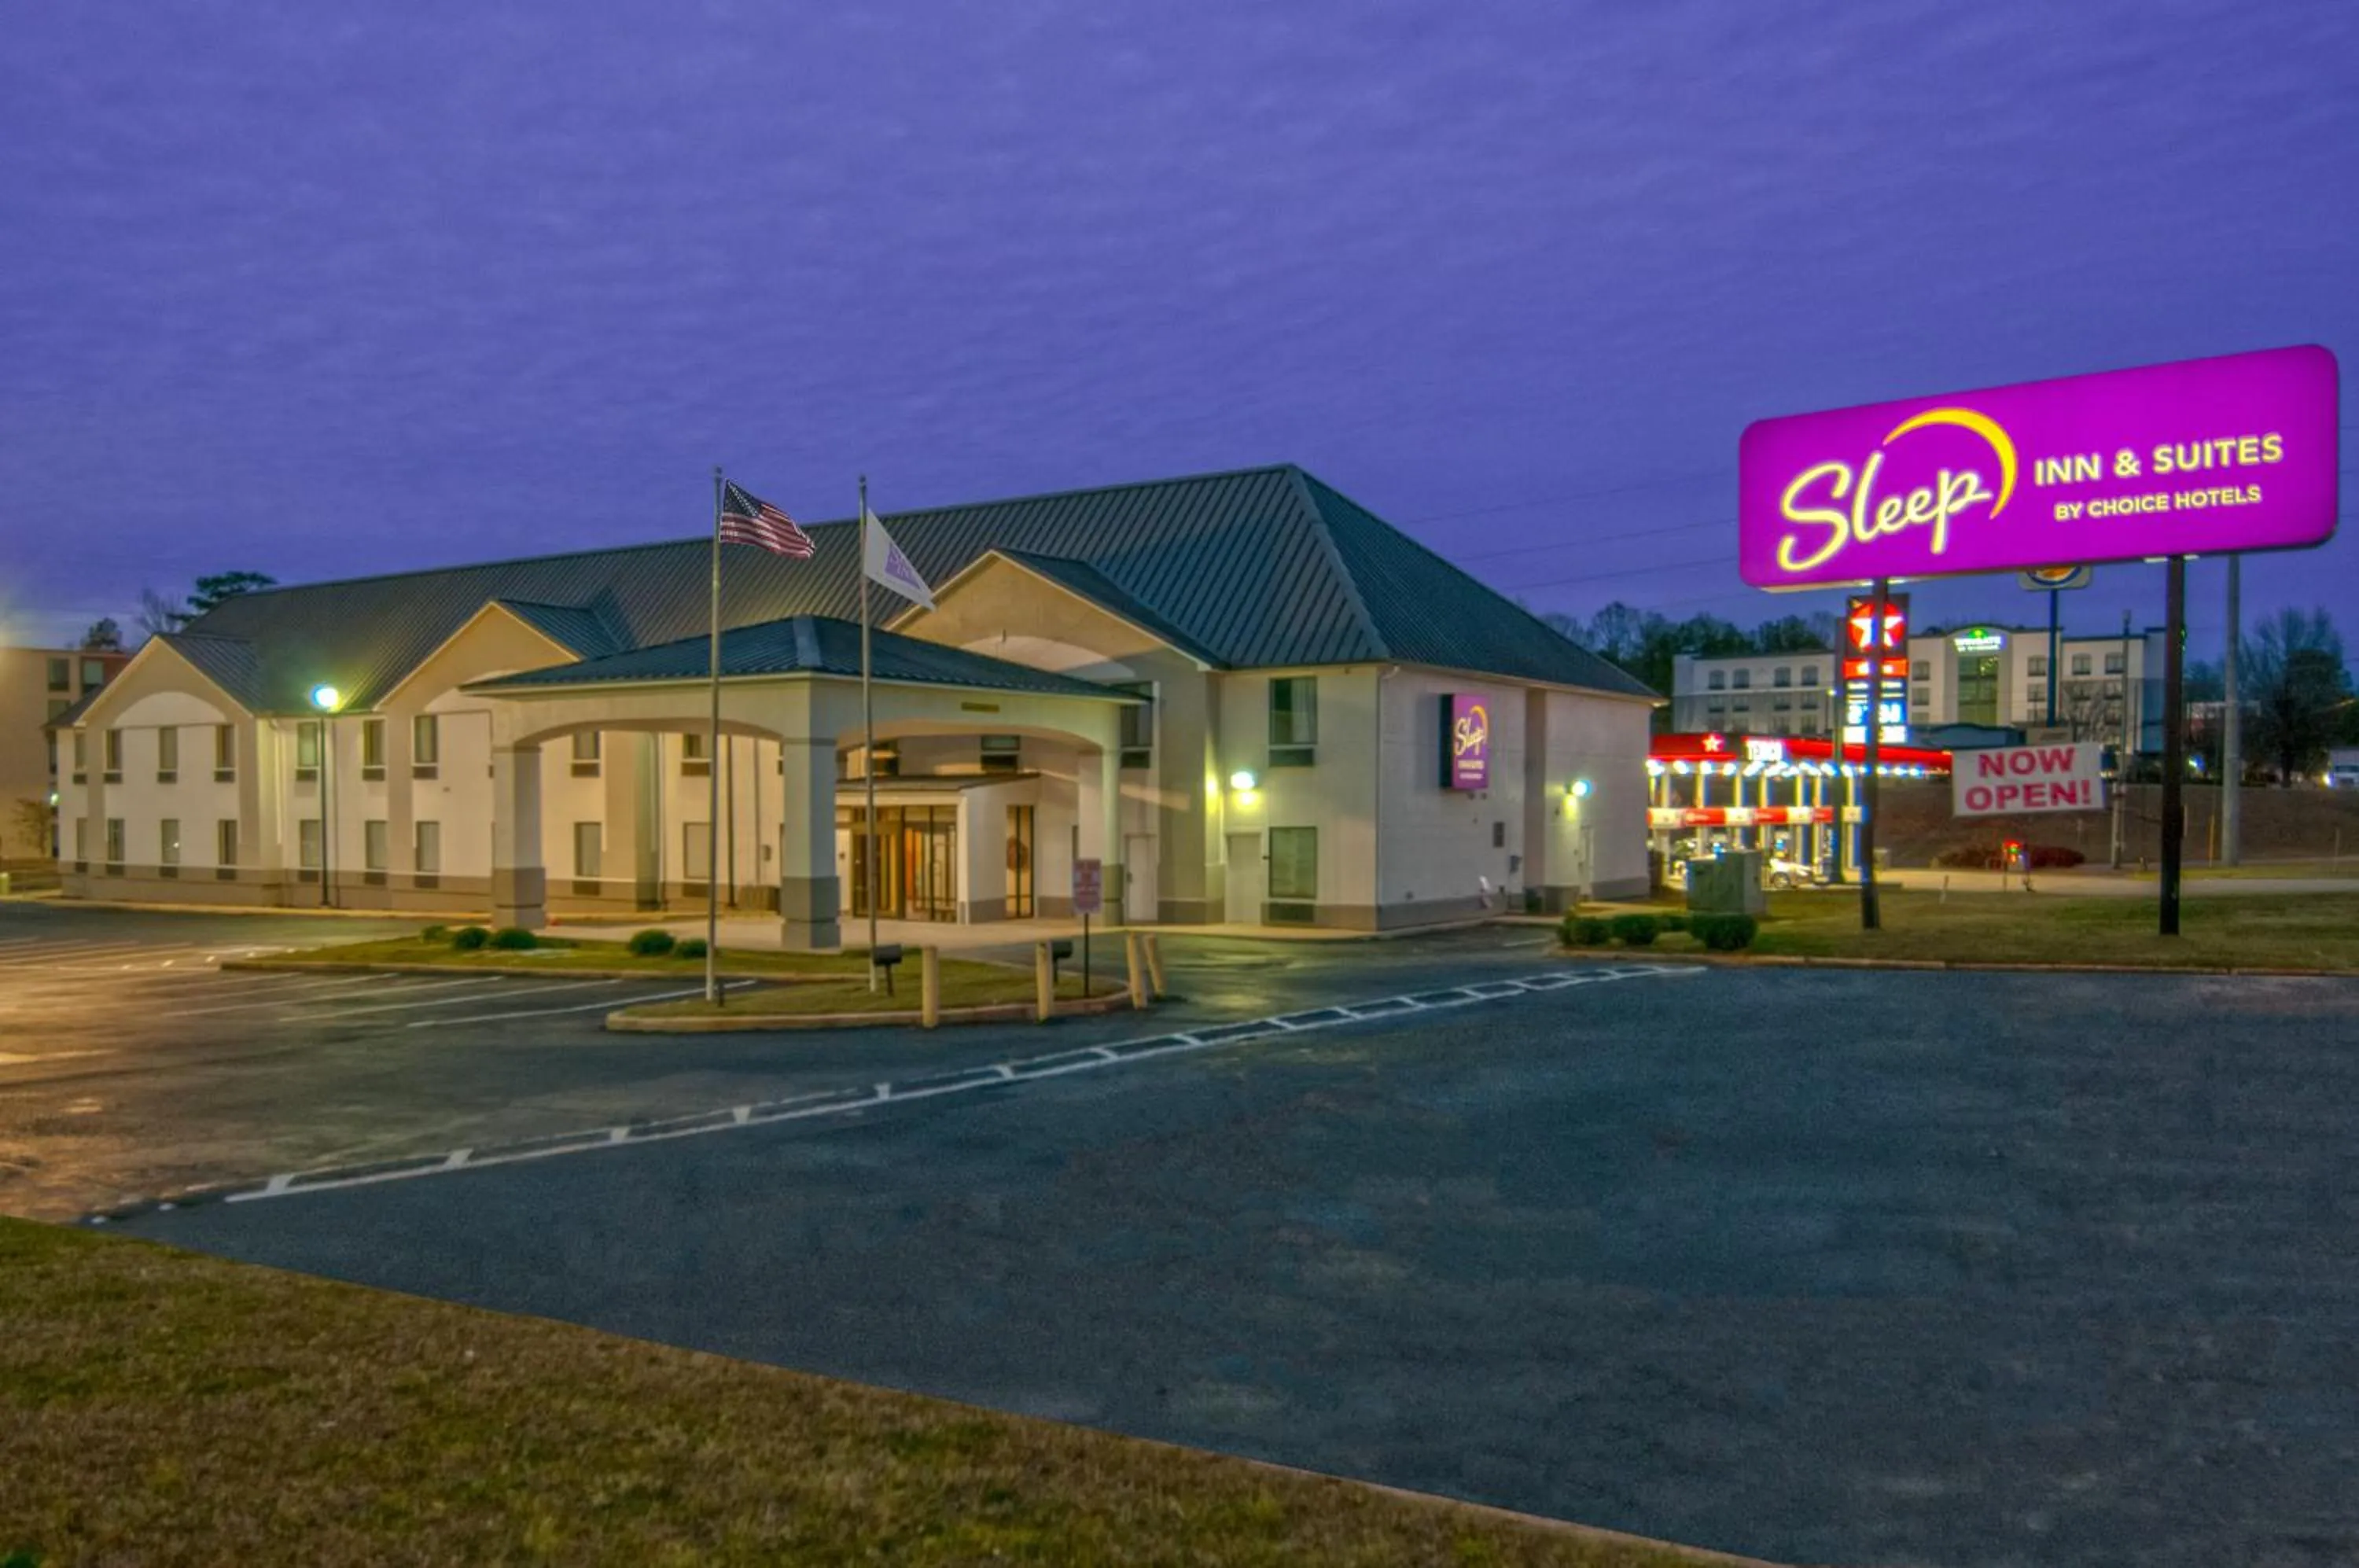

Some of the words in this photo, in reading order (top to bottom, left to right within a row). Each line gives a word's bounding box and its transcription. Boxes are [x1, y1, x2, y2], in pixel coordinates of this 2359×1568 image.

[2033, 452, 2102, 487] INN
[2114, 448, 2141, 477] &
[2152, 432, 2284, 473] SUITES
[1776, 449, 1994, 572] Sleep
[2053, 502, 2084, 521] BY
[2087, 493, 2169, 518] CHOICE
[2174, 484, 2261, 510] HOTELS
[1978, 745, 2075, 778] NOW
[1965, 778, 2092, 812] OPEN!
